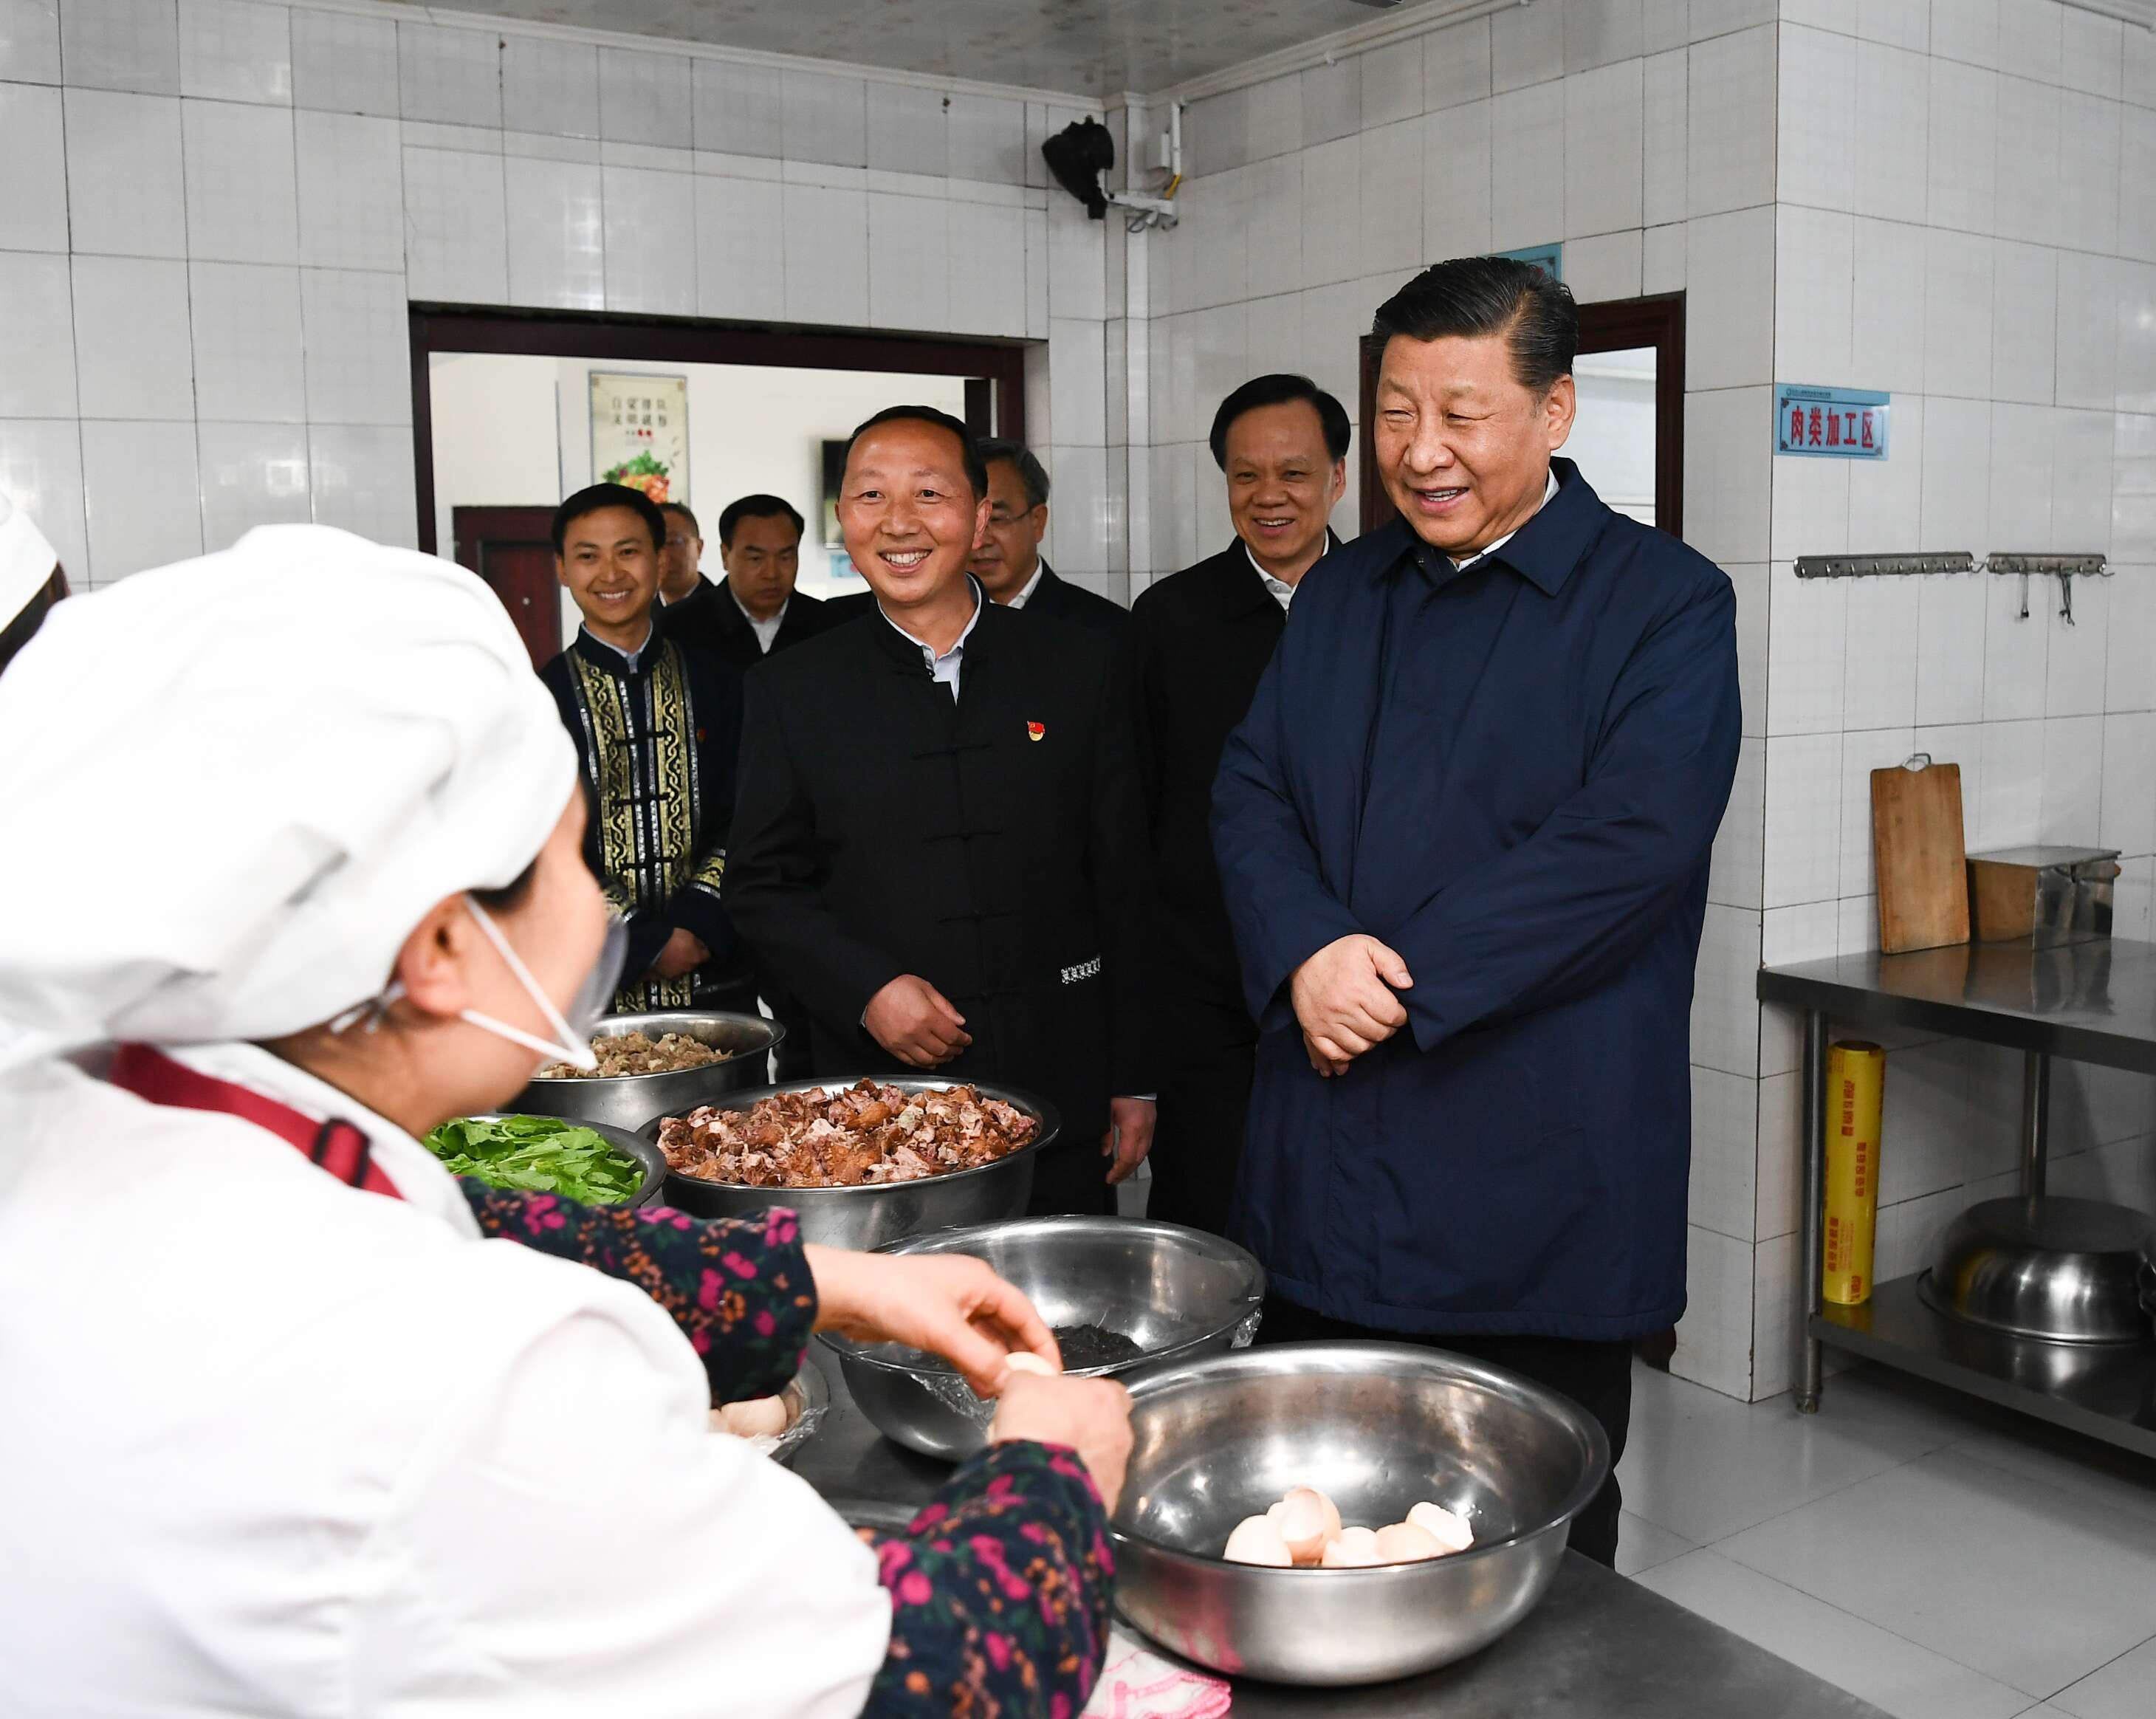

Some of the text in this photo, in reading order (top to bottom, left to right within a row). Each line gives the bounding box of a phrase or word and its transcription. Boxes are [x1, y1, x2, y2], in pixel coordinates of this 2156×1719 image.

[1791, 405, 1874, 448] 肉类加工区
